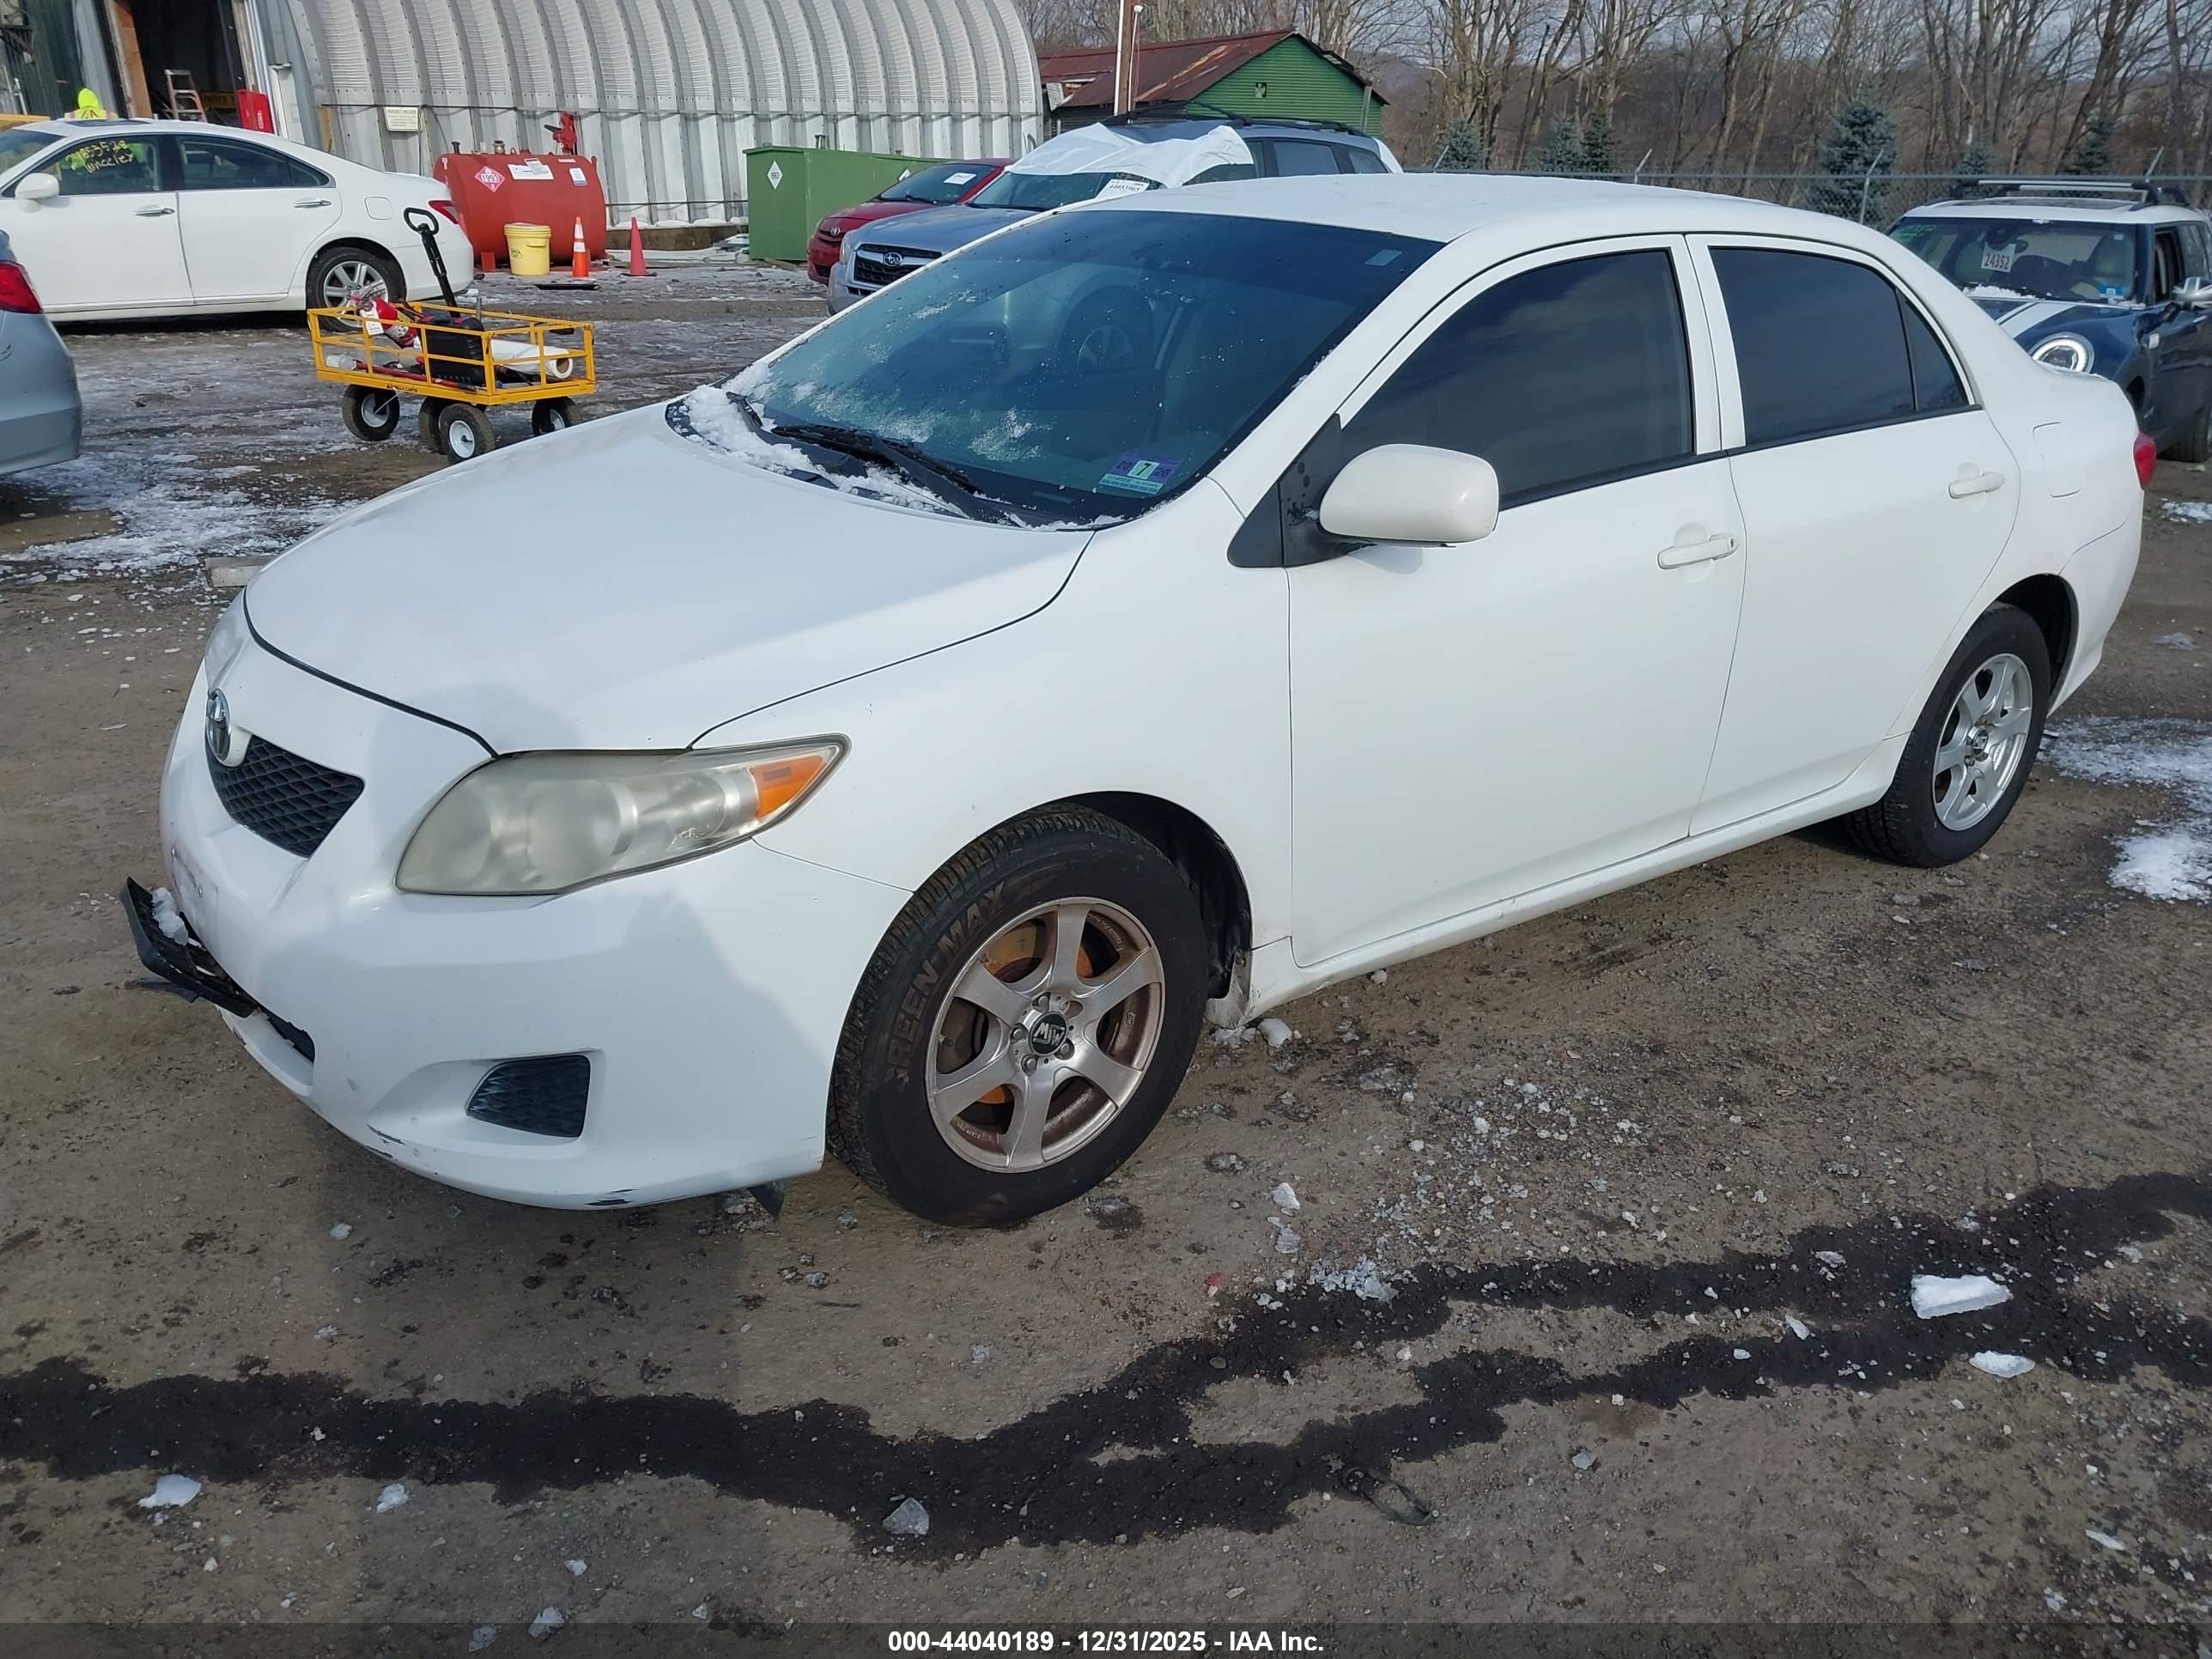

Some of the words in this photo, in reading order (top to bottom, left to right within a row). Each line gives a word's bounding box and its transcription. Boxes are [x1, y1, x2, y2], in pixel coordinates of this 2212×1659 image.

[1984, 252, 2010, 270] 24352
[1136, 462, 1152, 477] 7
[937, 881, 1005, 958] MAX
